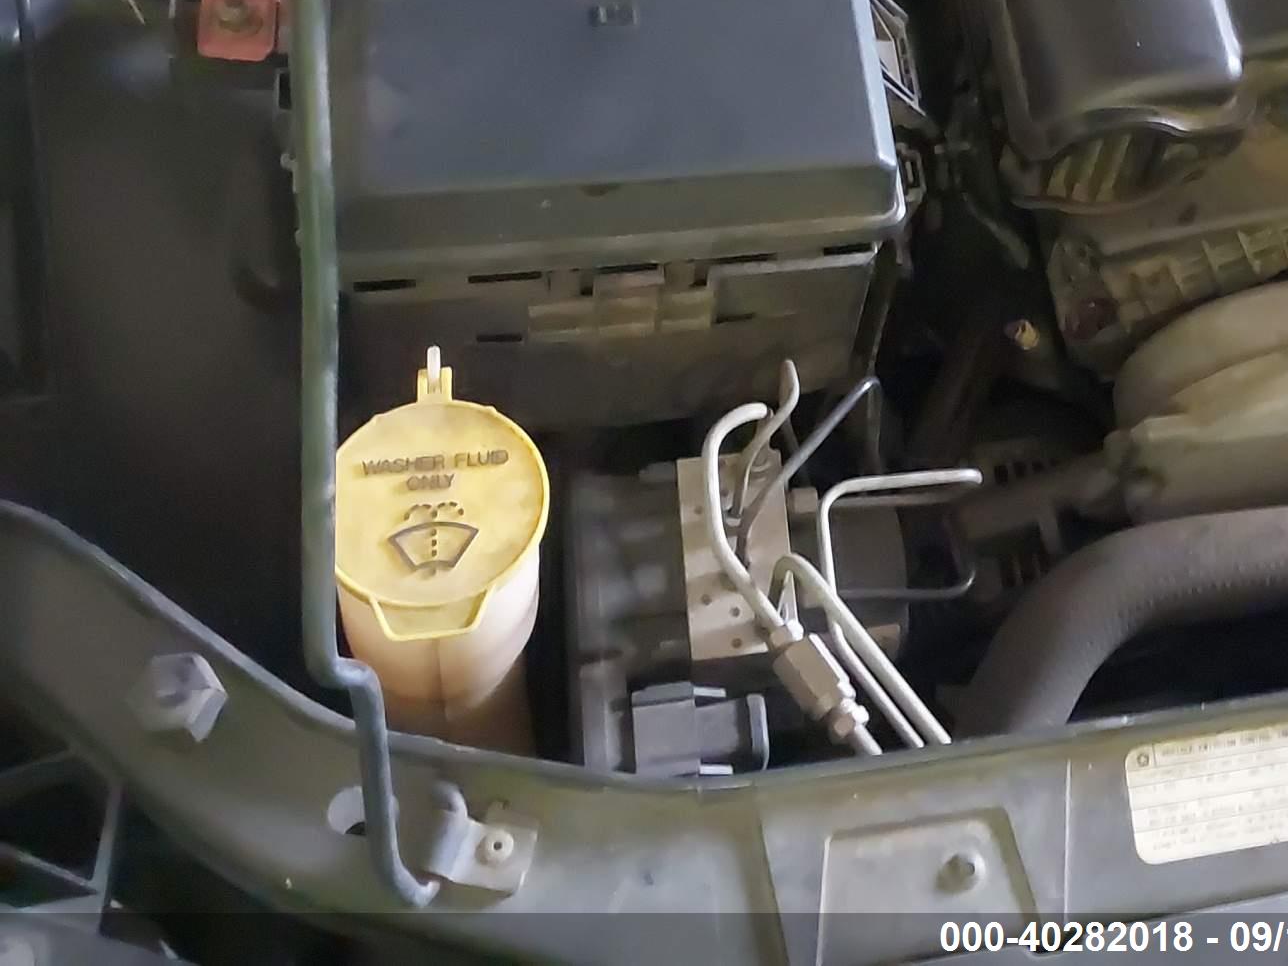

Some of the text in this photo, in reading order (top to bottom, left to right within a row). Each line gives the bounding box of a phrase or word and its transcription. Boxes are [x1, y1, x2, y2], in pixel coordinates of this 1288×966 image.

[362, 449, 509, 476] WASHER FLUID
[405, 473, 455, 492] ONLY
